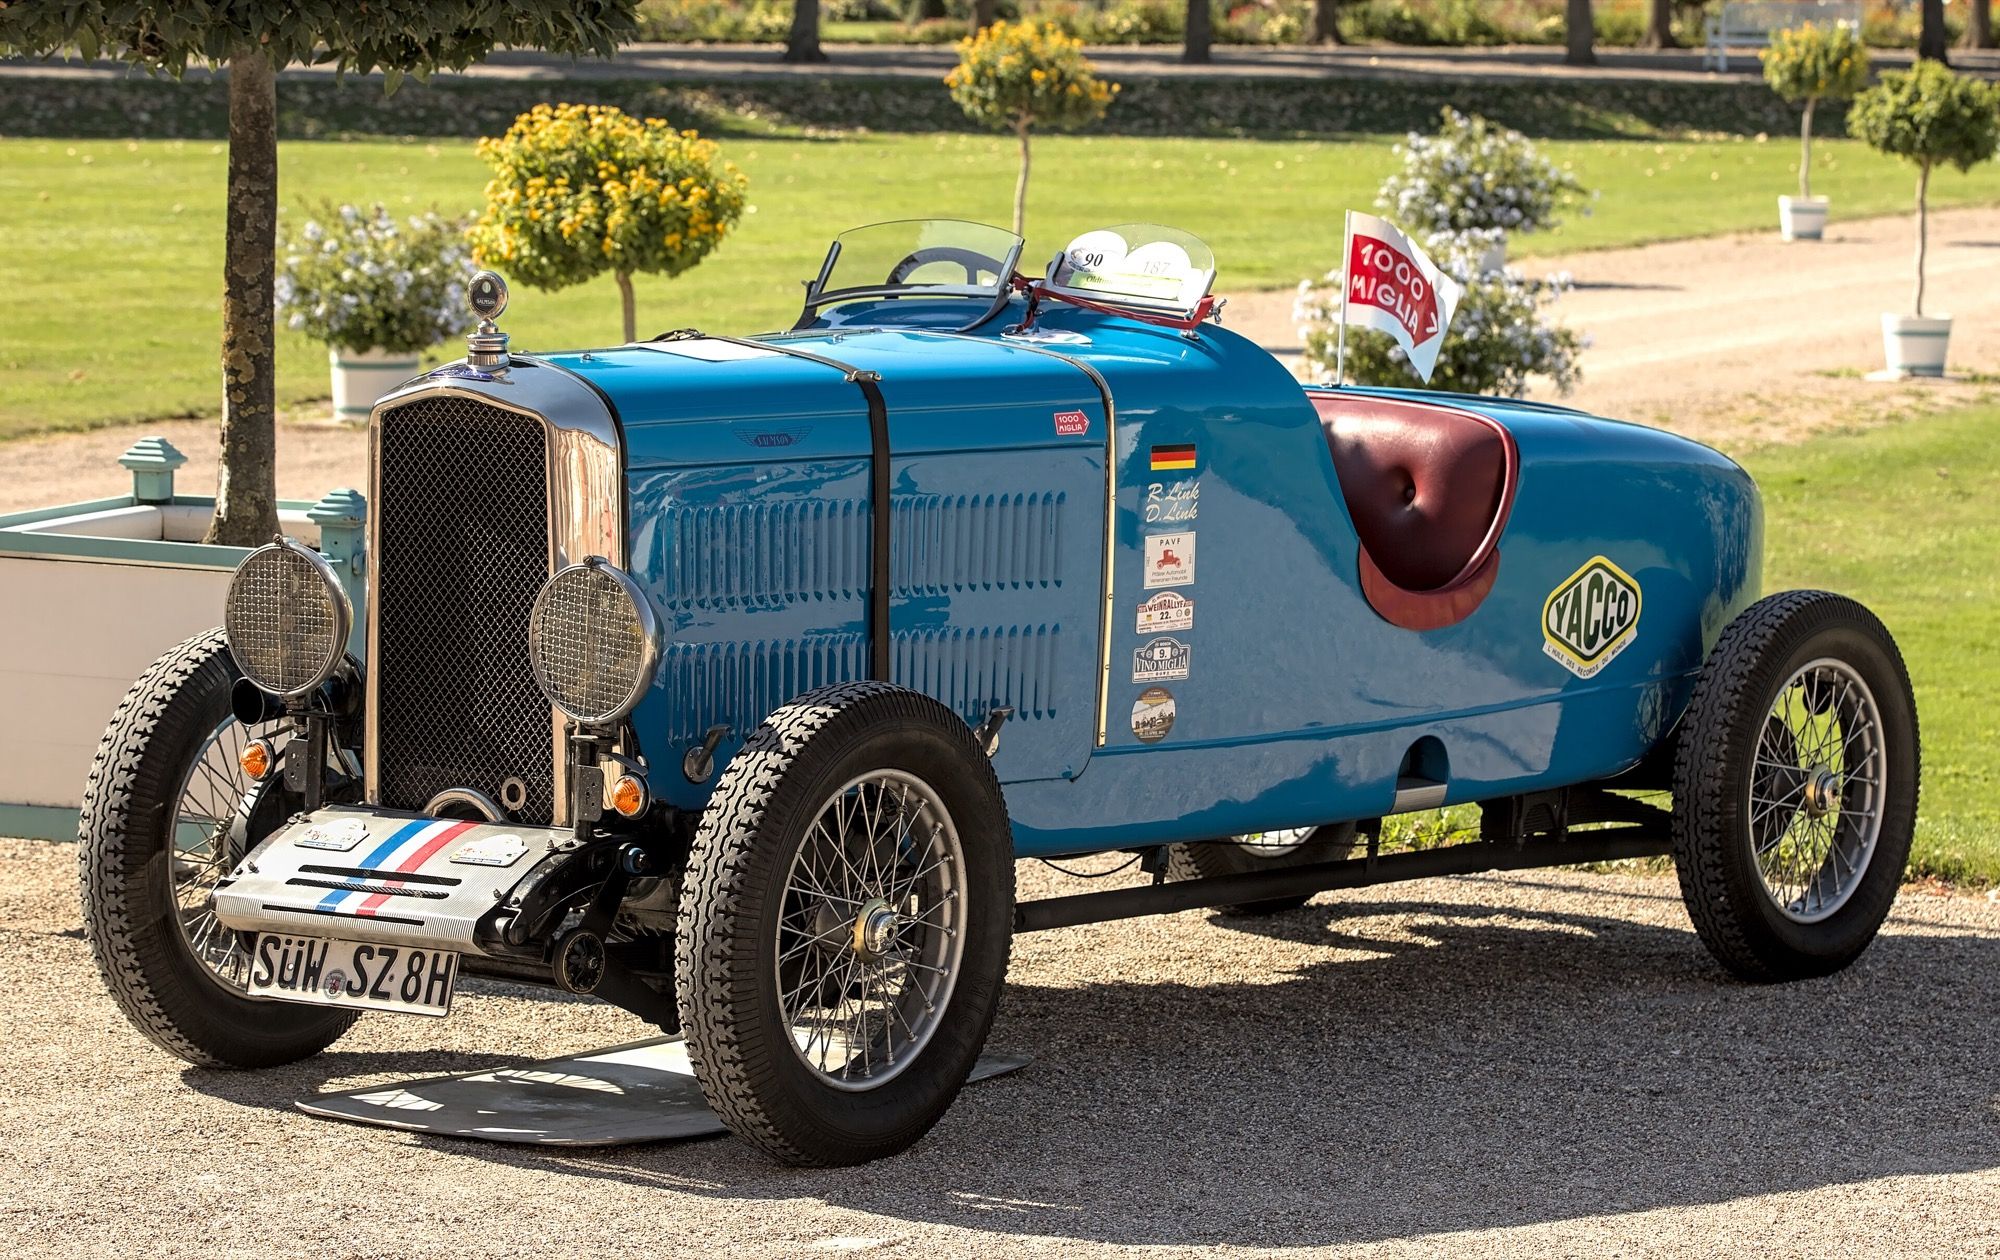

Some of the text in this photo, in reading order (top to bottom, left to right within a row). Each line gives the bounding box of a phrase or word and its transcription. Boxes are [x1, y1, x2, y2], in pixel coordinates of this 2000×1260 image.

[1082, 252, 1104, 267] 90
[1361, 243, 1424, 301] 1000
[1350, 274, 1419, 336] MIGLIA
[1059, 415, 1079, 423] 1000
[1059, 423, 1082, 432] MIGLIA
[1159, 611, 1172, 620] 22.
[1555, 572, 1629, 651] YACCO
[1159, 649, 1168, 659] 9.
[1136, 655, 1188, 672] VINO MIGLIA
[1565, 658, 1575, 670] DES
[1577, 663, 1599, 677] RECORDS
[1601, 655, 1609, 665] DU
[346, 945, 399, 1001] SZ
[400, 950, 454, 1007] 8H
